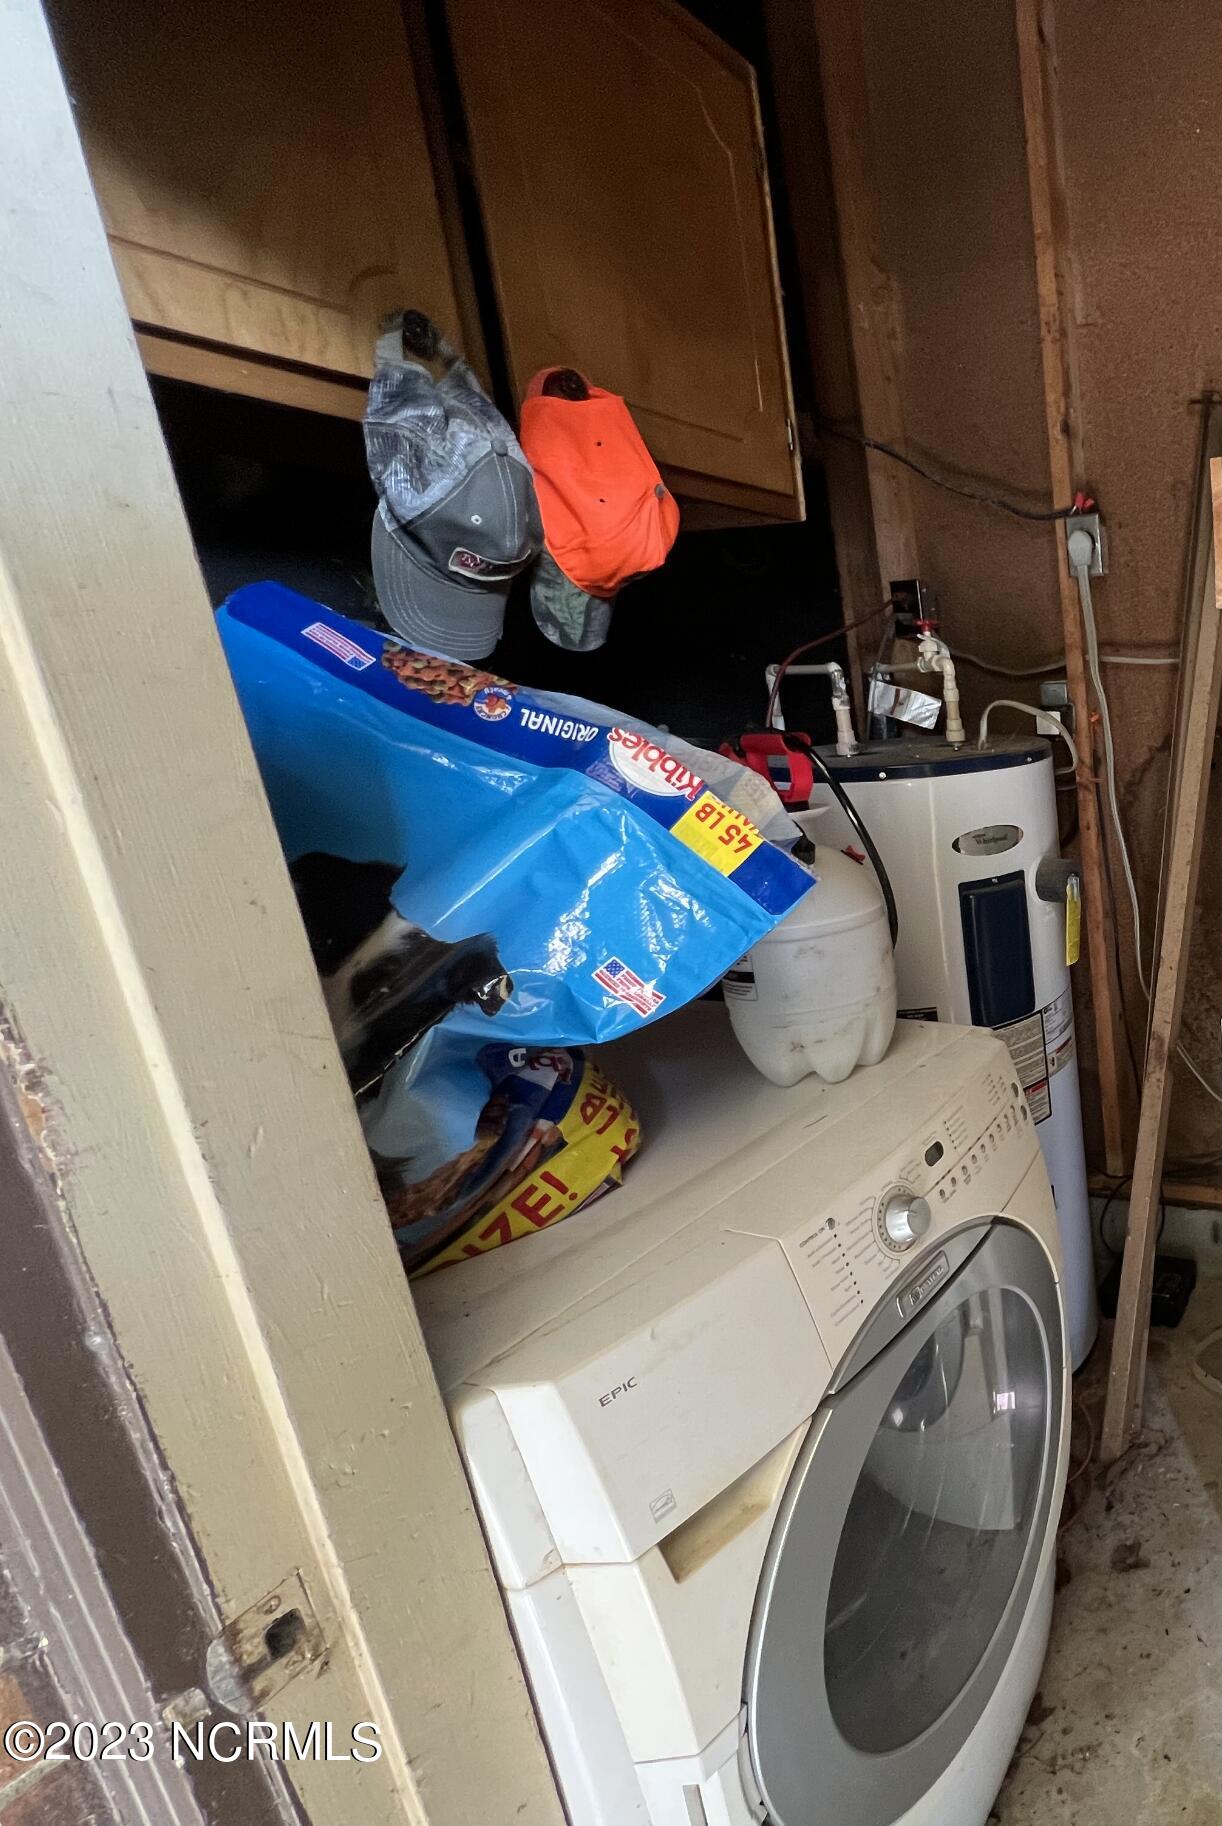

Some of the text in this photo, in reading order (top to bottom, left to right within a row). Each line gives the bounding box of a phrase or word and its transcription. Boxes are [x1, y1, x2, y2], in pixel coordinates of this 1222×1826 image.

[520, 708, 599, 742] ORIGINAL
[607, 727, 706, 801] Kibbles
[695, 802, 753, 854] 45 LB
[580, 1091, 622, 1136] LB
[599, 1376, 639, 1408] EPIC
